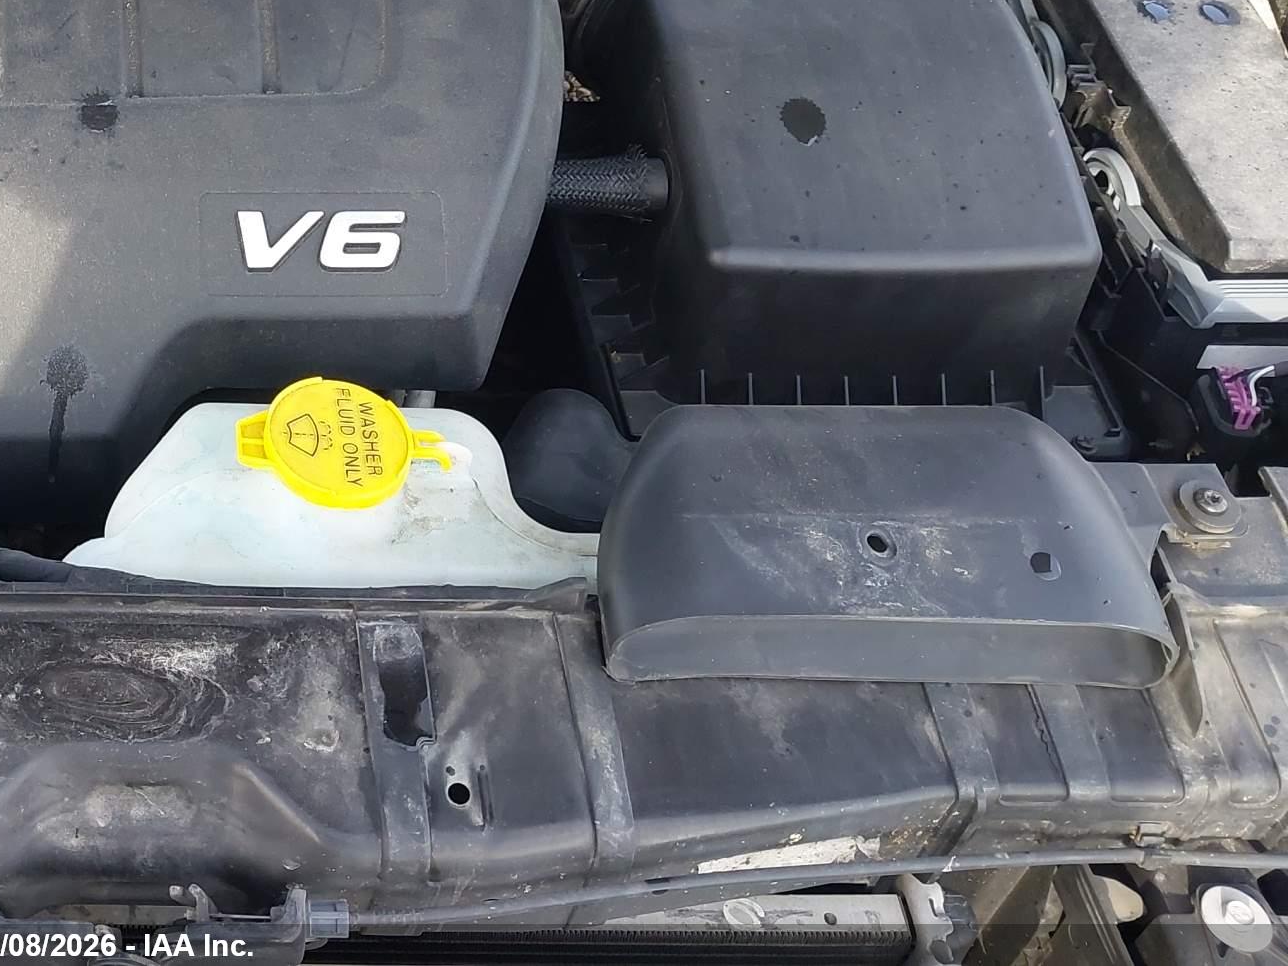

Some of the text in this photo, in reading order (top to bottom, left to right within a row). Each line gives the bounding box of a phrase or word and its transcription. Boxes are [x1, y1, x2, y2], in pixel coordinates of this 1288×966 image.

[236, 210, 406, 272] V6
[335, 387, 364, 487] FLUID ONLY
[358, 401, 384, 476] WASHER
